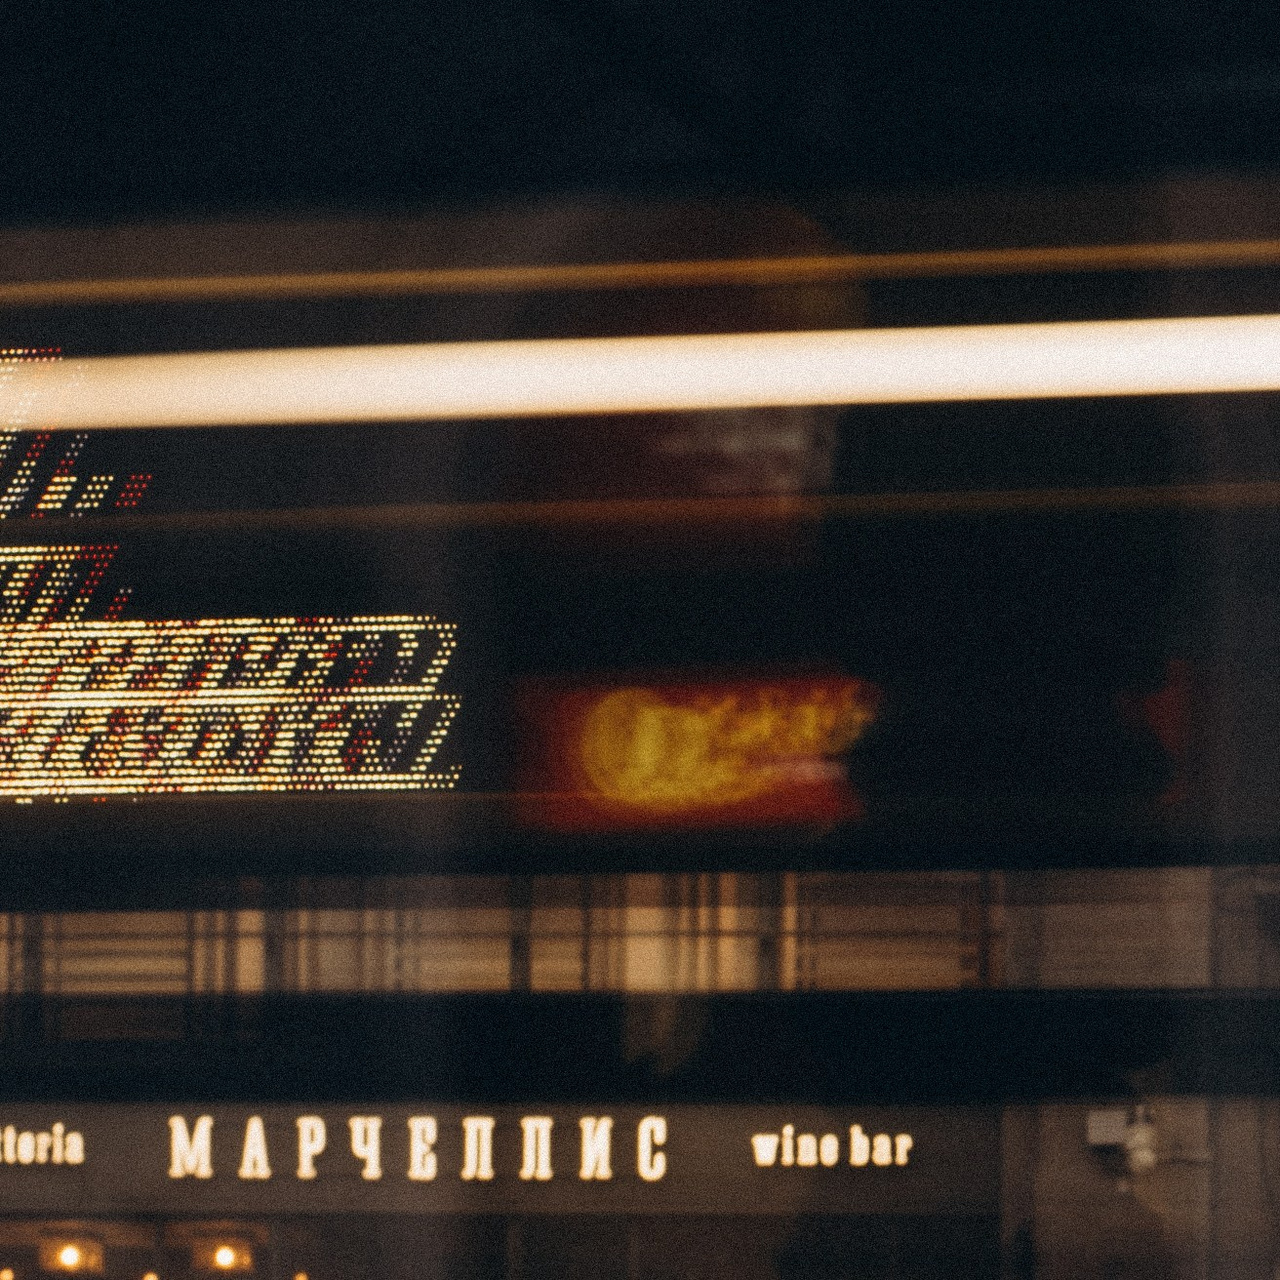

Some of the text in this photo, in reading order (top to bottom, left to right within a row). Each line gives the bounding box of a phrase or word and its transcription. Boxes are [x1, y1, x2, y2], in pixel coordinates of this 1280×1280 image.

[0, 1121, 85, 1165] toria
[167, 1114, 668, 1182] МАРЧЕЛЛИС
[750, 1122, 914, 1167] wine bar
